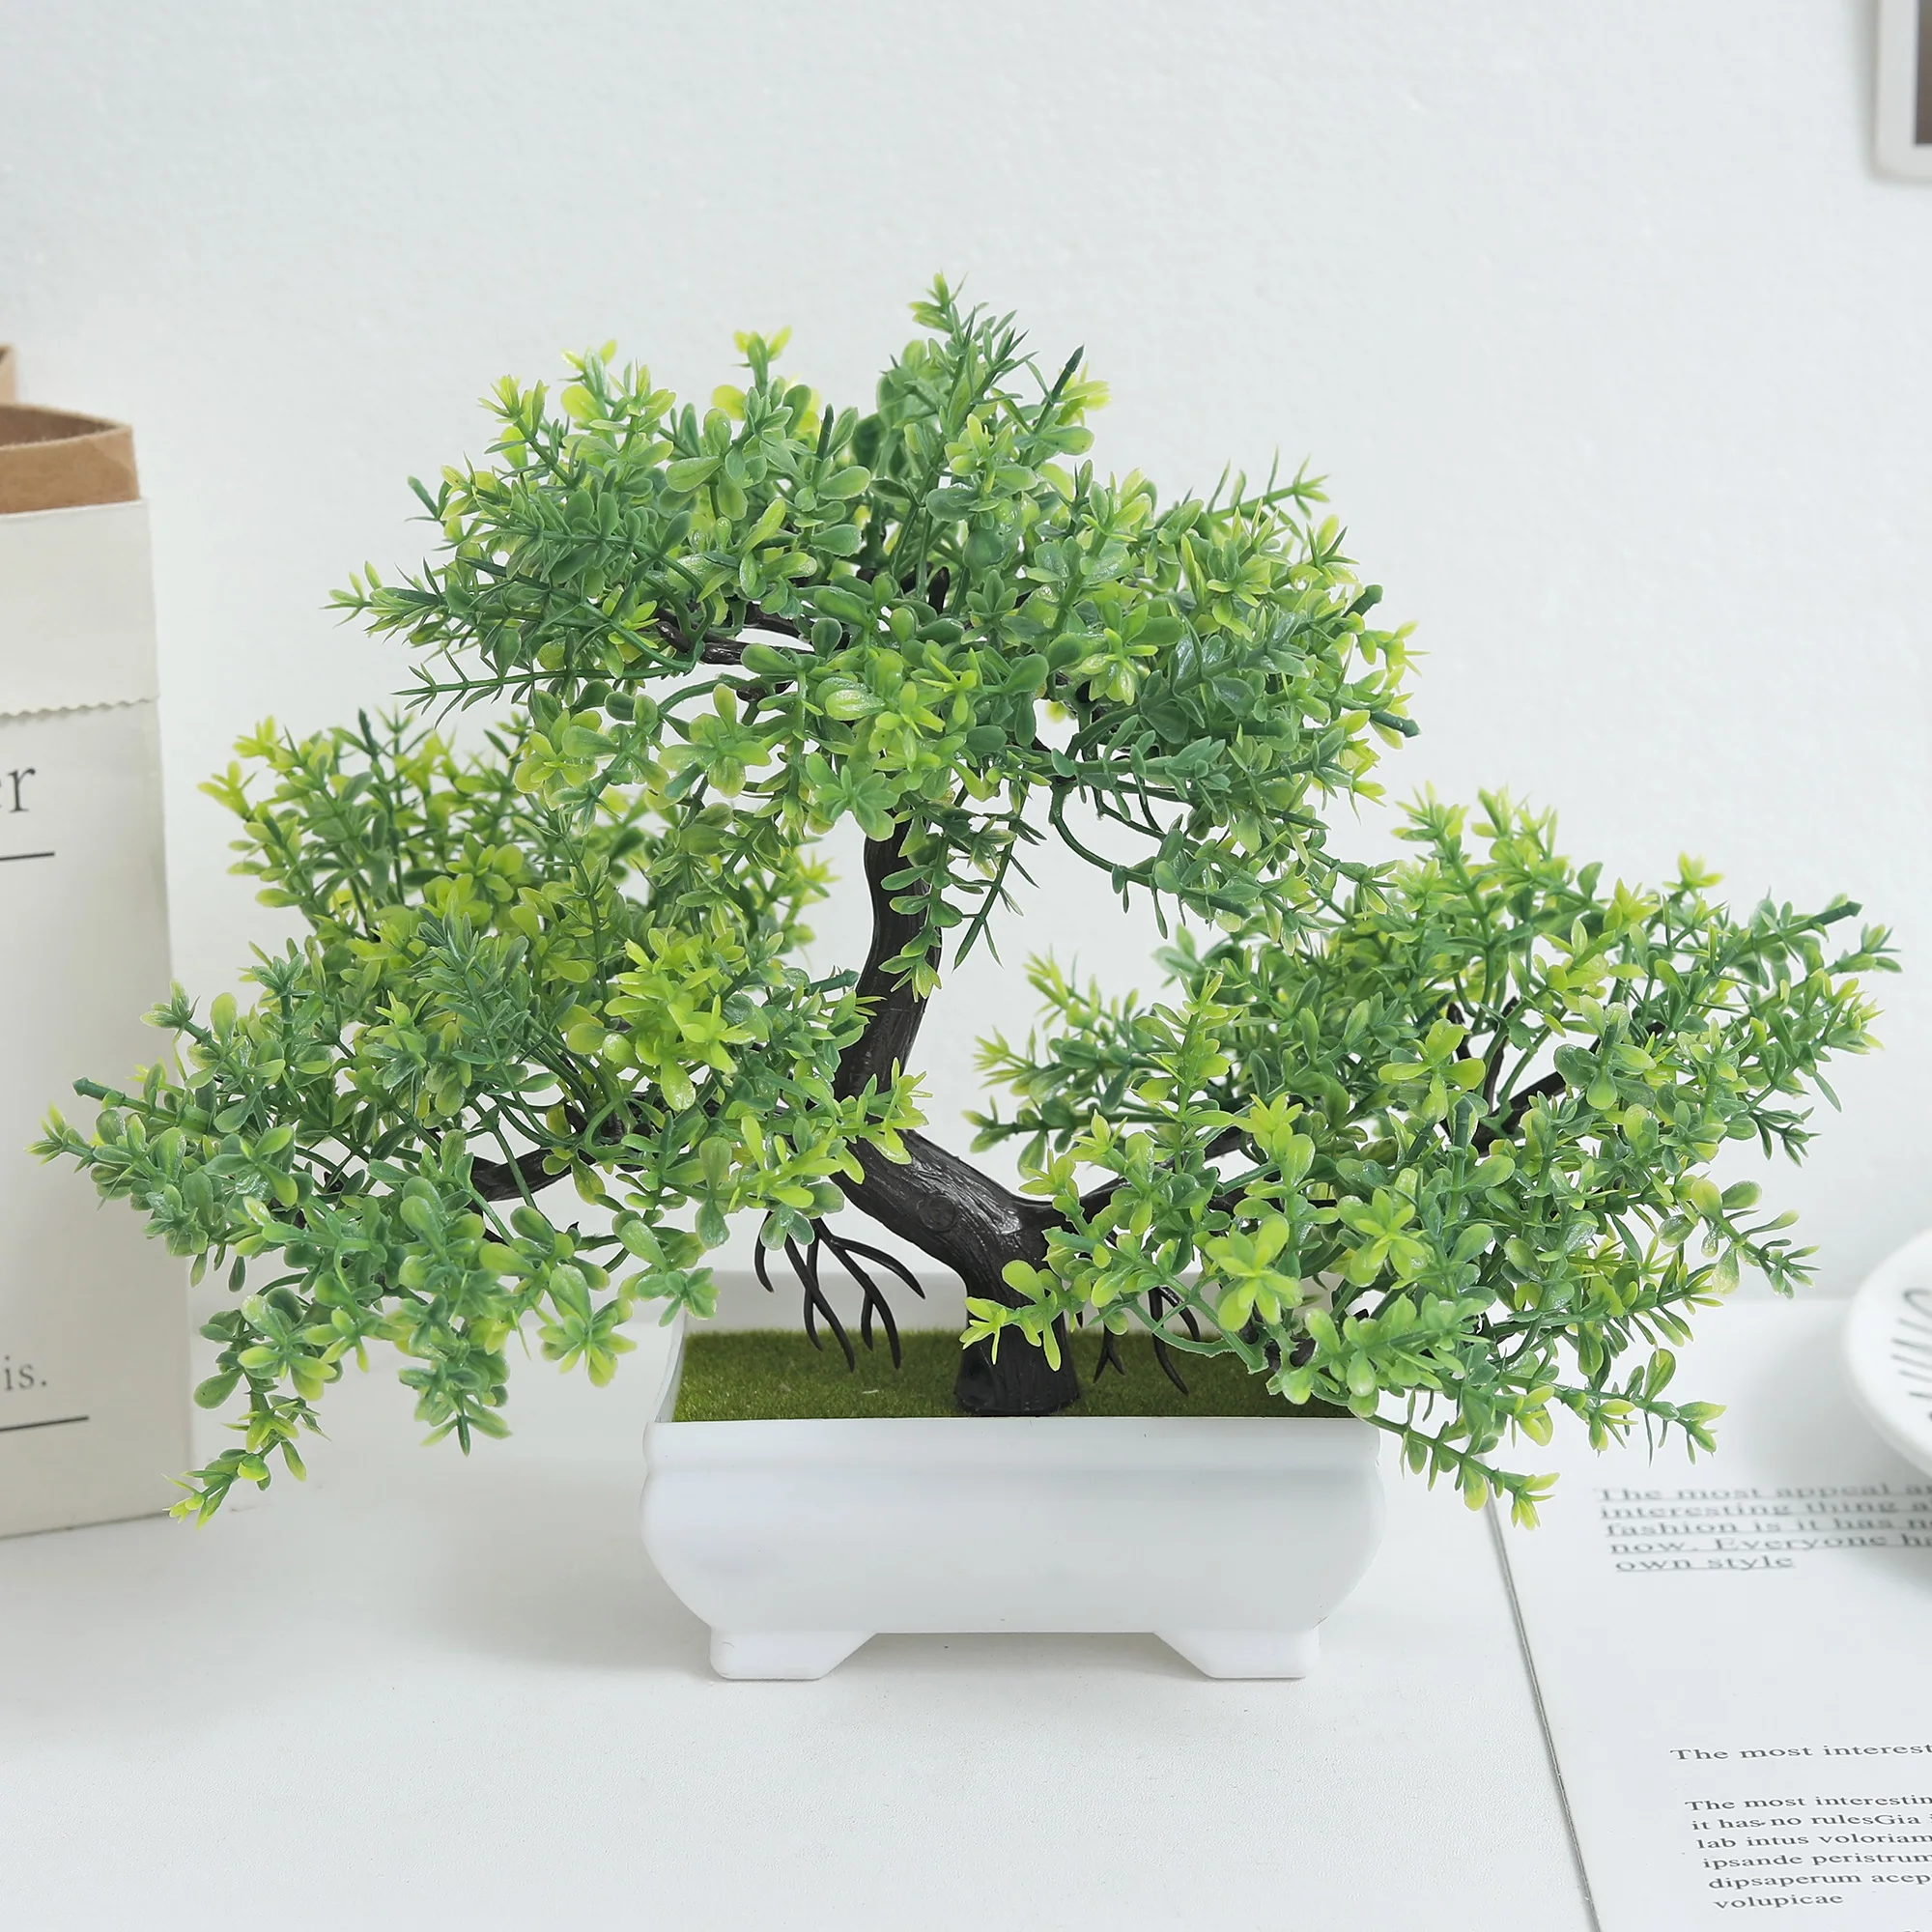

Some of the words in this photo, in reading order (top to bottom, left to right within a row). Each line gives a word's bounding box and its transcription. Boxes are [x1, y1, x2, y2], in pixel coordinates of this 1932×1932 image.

[0, 767, 36, 813] r
[4, 1355, 47, 1391] is.
[1594, 1488, 1662, 1500] The
[1678, 1488, 1758, 1499] most
[1776, 1483, 1889, 1498] appeal
[1601, 1503, 1789, 1519] interesting
[1806, 1500, 1898, 1514] thing
[1607, 1520, 1738, 1536] fashion
[1753, 1518, 1780, 1532] is
[1796, 1518, 1818, 1531] it
[1833, 1517, 1893, 1529] has
[1715, 1536, 1887, 1551] Everyone
[1615, 1557, 1692, 1571] own
[1708, 1554, 1795, 1571] style
[1670, 1748, 1729, 1760] The
[1739, 1747, 1813, 1759] most
[1823, 1744, 1932, 1756] interest
[1685, 1800, 1736, 1811] The
[1743, 1797, 1807, 1808] most
[1814, 1794, 1932, 1806] interestin
[1691, 1820, 1712, 1831] it
[1770, 1817, 1803, 1827] no
[1810, 1814, 1921, 1825] rulesGia
[1696, 1837, 1737, 1850] lab
[1746, 1835, 1809, 1847] intus
[1817, 1833, 1932, 1844] voloriam
[1702, 1854, 1804, 1871] ipsande
[1810, 1852, 1932, 1866] peristrum
[1708, 1873, 1862, 1890] dipsaperum
[1713, 1894, 1844, 1910] volupicae
